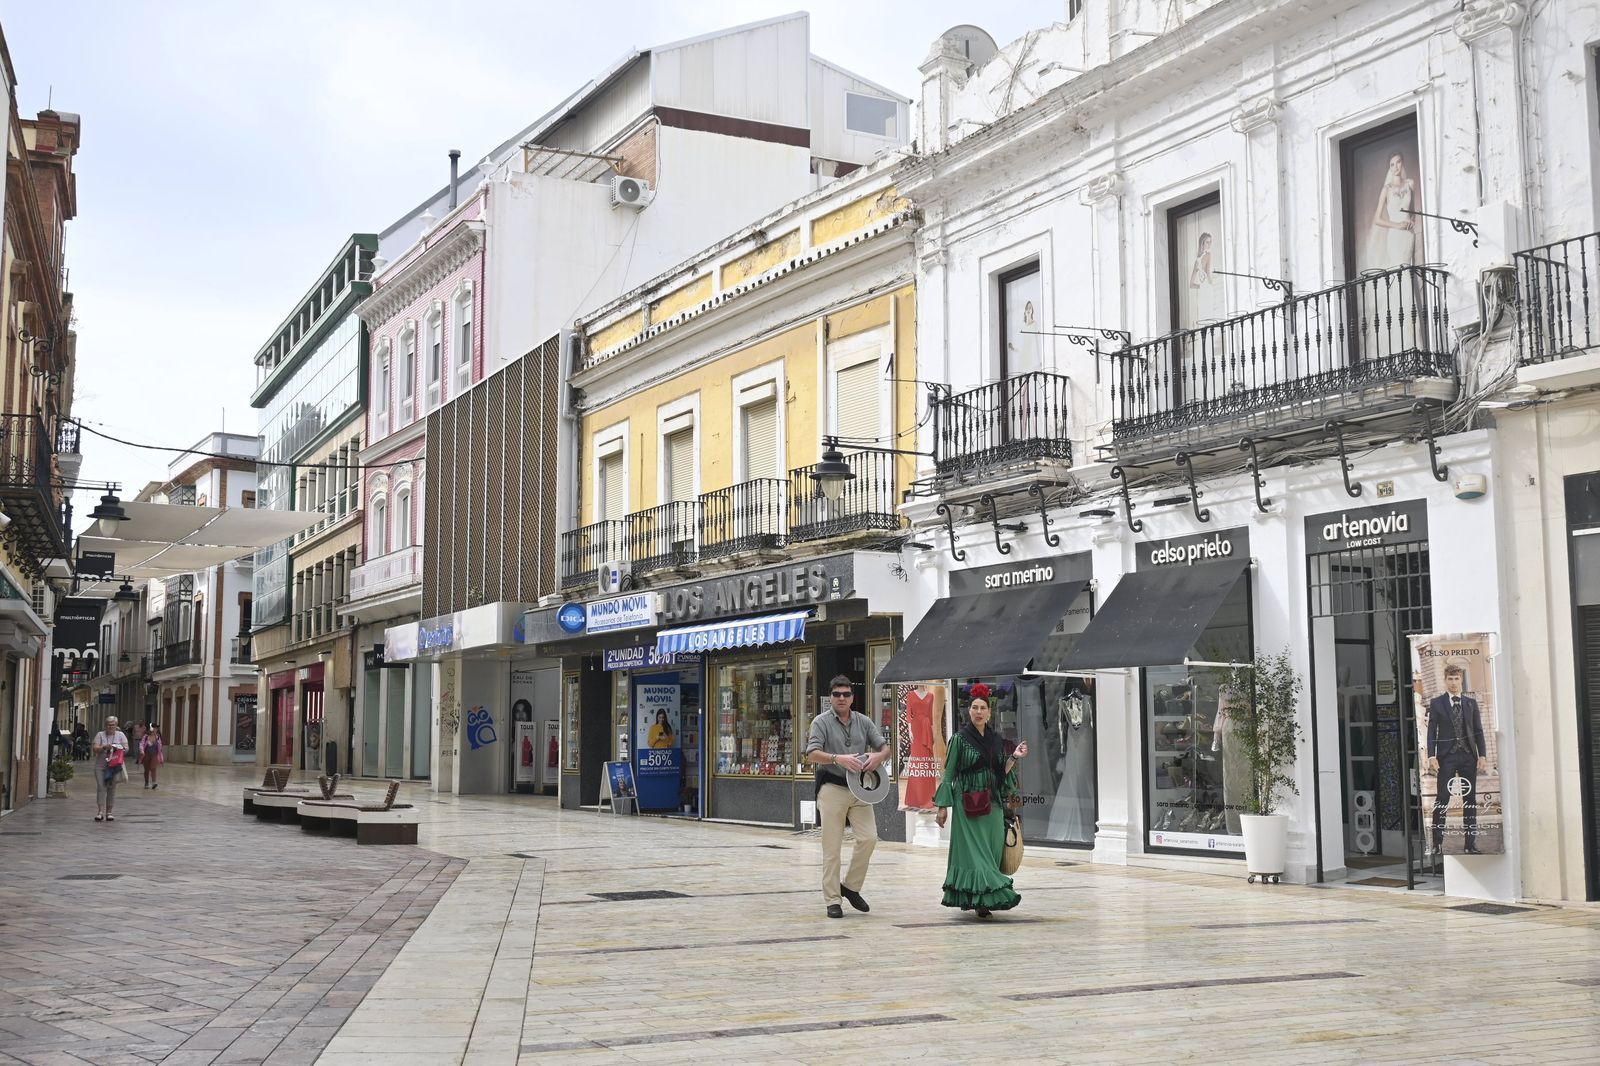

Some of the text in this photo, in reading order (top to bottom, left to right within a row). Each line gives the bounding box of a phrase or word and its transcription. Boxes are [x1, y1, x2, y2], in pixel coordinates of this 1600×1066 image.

[1323, 510, 1408, 541] artenovia
[1346, 537, 1381, 549] LOW COST
[1151, 533, 1232, 566] celso prieto
[985, 564, 1054, 588] sara merino
[664, 564, 828, 619] LOS ANGELES
[591, 600, 620, 617] MUNDO
[560, 615, 585, 623] DIGI
[688, 626, 766, 648] LOS ANGELES
[1451, 648, 1480, 656] PRIETO
[643, 687, 676, 695] MUNDO
[648, 754, 672, 766] 50%
[903, 762, 929, 770] TRAJES
[902, 769, 941, 778] MADRINA
[1022, 793, 1045, 806] prieto
